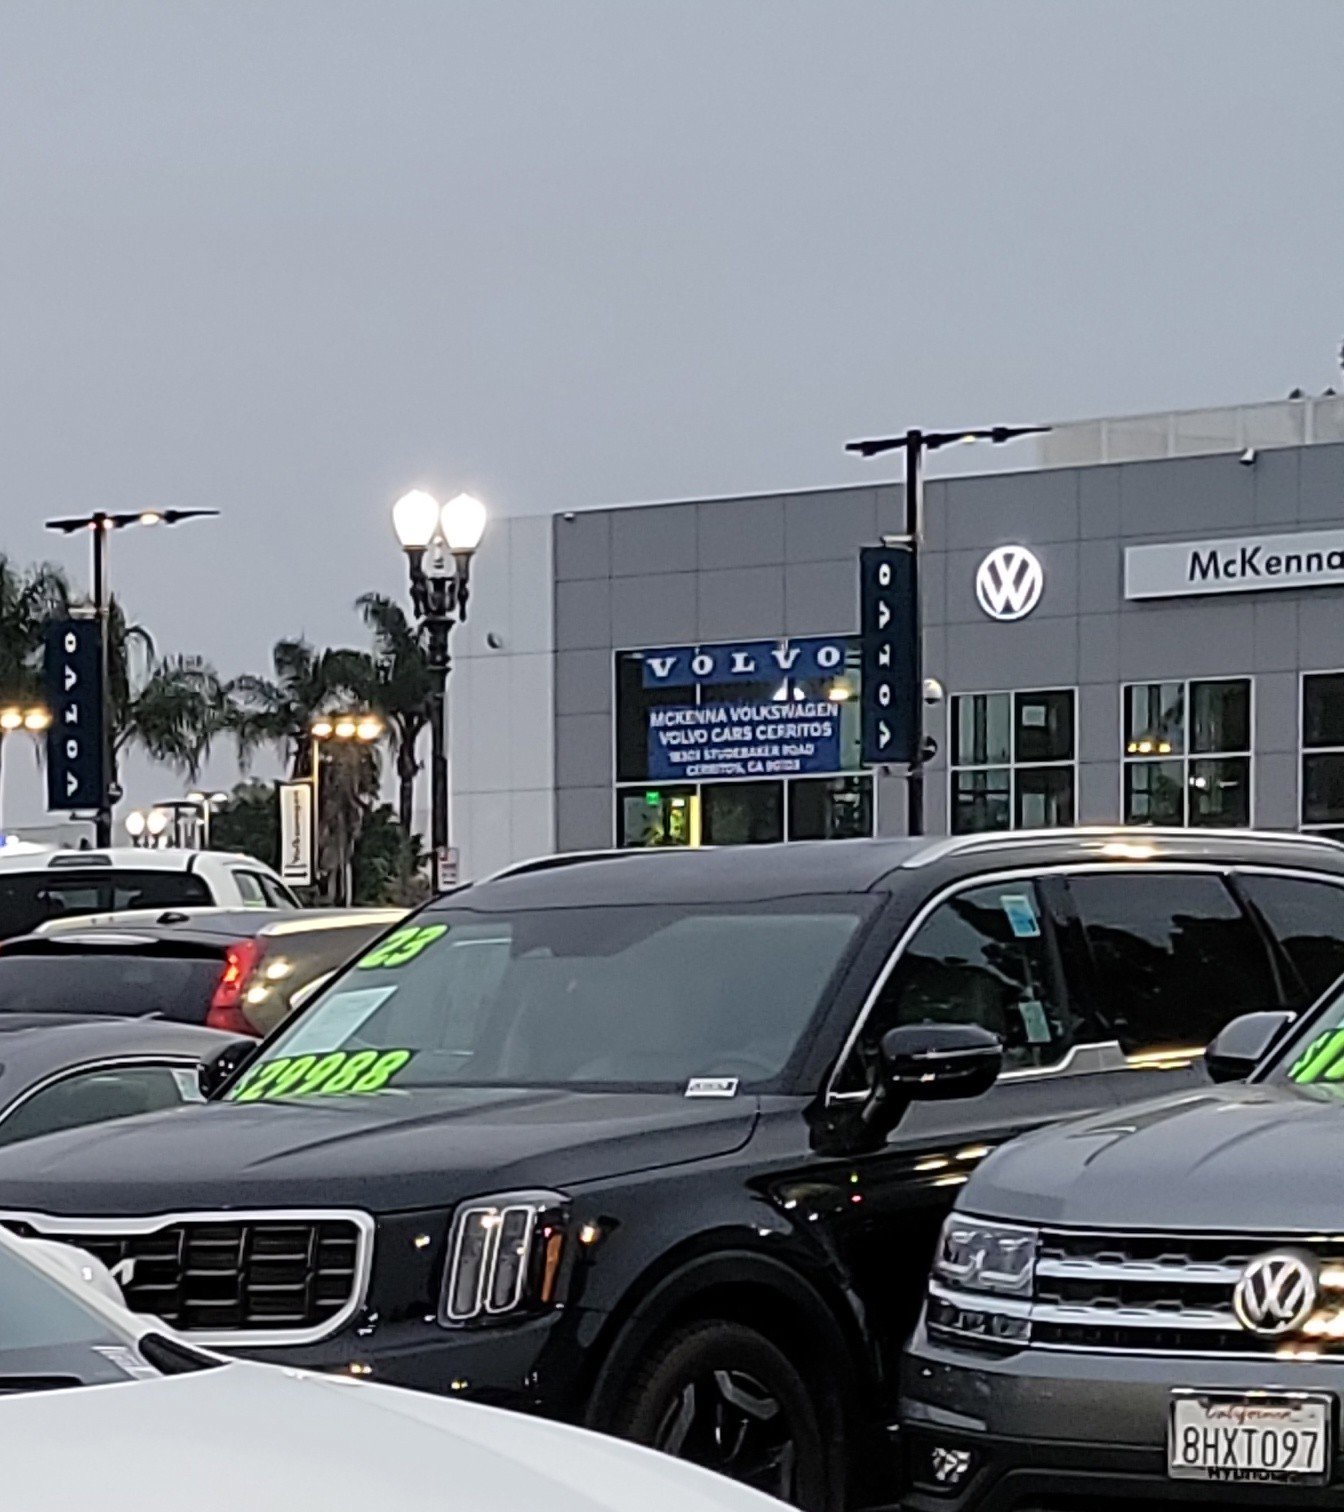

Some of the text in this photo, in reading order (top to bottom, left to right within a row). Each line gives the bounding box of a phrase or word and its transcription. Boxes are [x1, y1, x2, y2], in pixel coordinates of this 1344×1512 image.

[1189, 545, 1344, 581] McKenna
[646, 646, 841, 678] VOLVO
[878, 562, 891, 749] VOLVO
[64, 631, 79, 797] VOLVO
[650, 703, 839, 727] MCKENNA VOLKSWAGEN
[659, 721, 832, 745] VOLVO CARS CERRITOS
[357, 924, 449, 969] 23
[1183, 1426, 1318, 1468] 8HXT097
